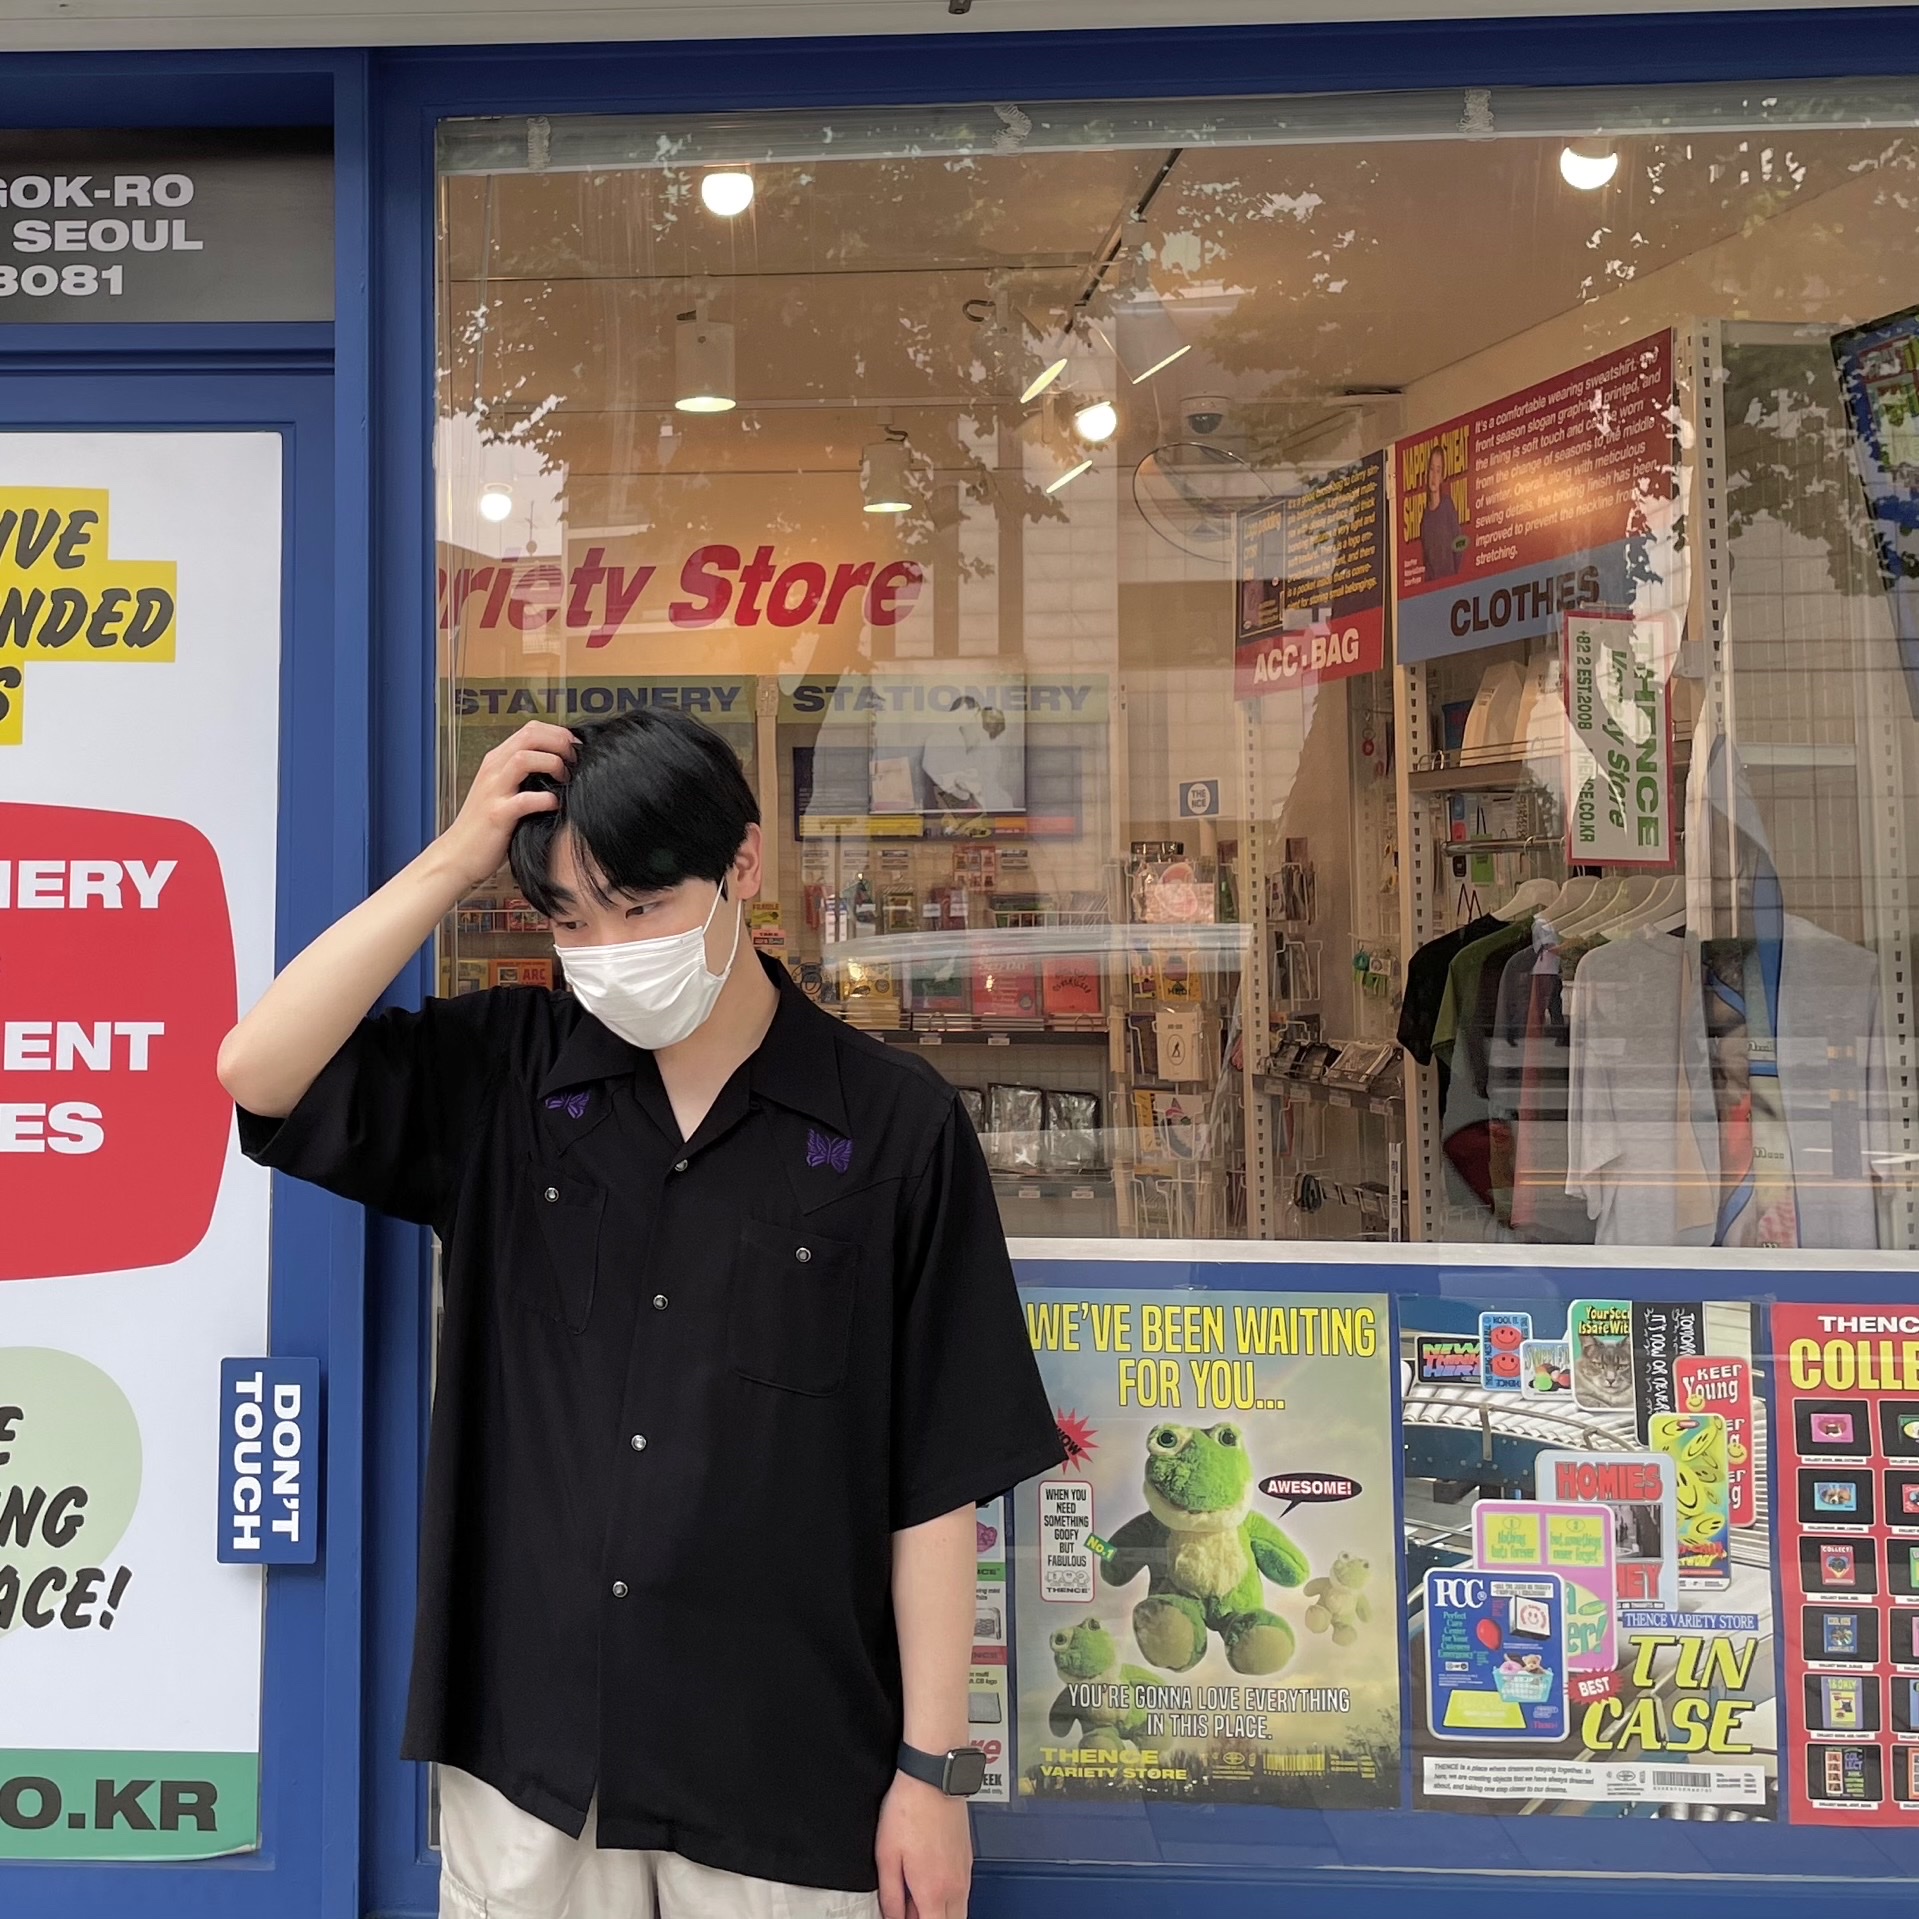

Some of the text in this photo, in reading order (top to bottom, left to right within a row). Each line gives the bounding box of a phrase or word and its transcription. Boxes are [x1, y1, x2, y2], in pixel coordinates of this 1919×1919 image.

[0, 174, 194, 208] OK-RO
[12, 219, 203, 252] SEOUL
[1475, 436, 1494, 452] front
[1496, 428, 1526, 445] season
[1527, 413, 1556, 433] slogan
[1642, 368, 1662, 388] and
[1489, 418, 1495, 429] a
[1495, 395, 1546, 426] comfortable
[1548, 381, 1583, 404] wearing
[1475, 400, 1644, 471] the lining is soft touch and worn
[1475, 417, 1655, 490] from the change of seasons to the middle
[1475, 494, 1484, 509] of
[1548, 467, 1572, 485] along
[1574, 459, 1593, 476] with
[1595, 441, 1646, 467] meticulous
[1475, 509, 1504, 528] sewing
[1537, 494, 1551, 508] the
[1553, 484, 1585, 502] binding
[1587, 475, 1611, 492] finish
[1613, 467, 1630, 484] has
[1475, 523, 1513, 547] improved
[1515, 522, 1523, 535] to
[1524, 511, 1558, 536] prevent
[1560, 508, 1574, 522] the
[1576, 495, 1613, 517] neckline
[1475, 544, 1518, 566] stretching.
[668, 544, 923, 628] Store
[1450, 565, 1600, 636] CLOTHES
[1576, 656, 1591, 665] 2
[453, 687, 742, 715] STATIONERY
[793, 685, 1092, 712] STATIONERY
[1577, 668, 1593, 730] EST.2008
[1191, 789, 1206, 798] THE
[1607, 750, 1631, 829] Store
[0, 860, 178, 909] ERY
[3, 1021, 165, 1071] ENT
[0, 1101, 104, 1154] ES
[1027, 1301, 1377, 1358] WE'VE BEEN WAITING
[1118, 1358, 1286, 1411] FOR YOU...
[1683, 1375, 1738, 1403] Young
[233, 1371, 263, 1549] TOUCH
[271, 1384, 301, 1542] DON'T
[1045, 1489, 1087, 1501] WHEN YOU
[1268, 1480, 1352, 1496] AWESOME!
[1555, 1461, 1664, 1501] HOMIES
[1044, 1515, 1089, 1528] SOMETHING
[1056, 1502, 1076, 1514] NEED
[1054, 1529, 1079, 1540] GOOFY
[1059, 1542, 1074, 1554] BUT
[1047, 1555, 1087, 1567] FABULOUS
[1625, 1613, 1755, 1629] THENCE VARIETY STORE
[1627, 1635, 1759, 1692] TIN
[1068, 1684, 1351, 1714] YOU'RE GONNA LOVE EVERYTHING
[1578, 1677, 1610, 1697] BEST
[1146, 1713, 1273, 1740] IN THIS PLACE.
[1581, 1697, 1755, 1754] CASE
[1039, 1747, 1159, 1765] THENCE
[1040, 1765, 1188, 1780] VARIETY STORE
[0, 1776, 218, 1832] O.KR
